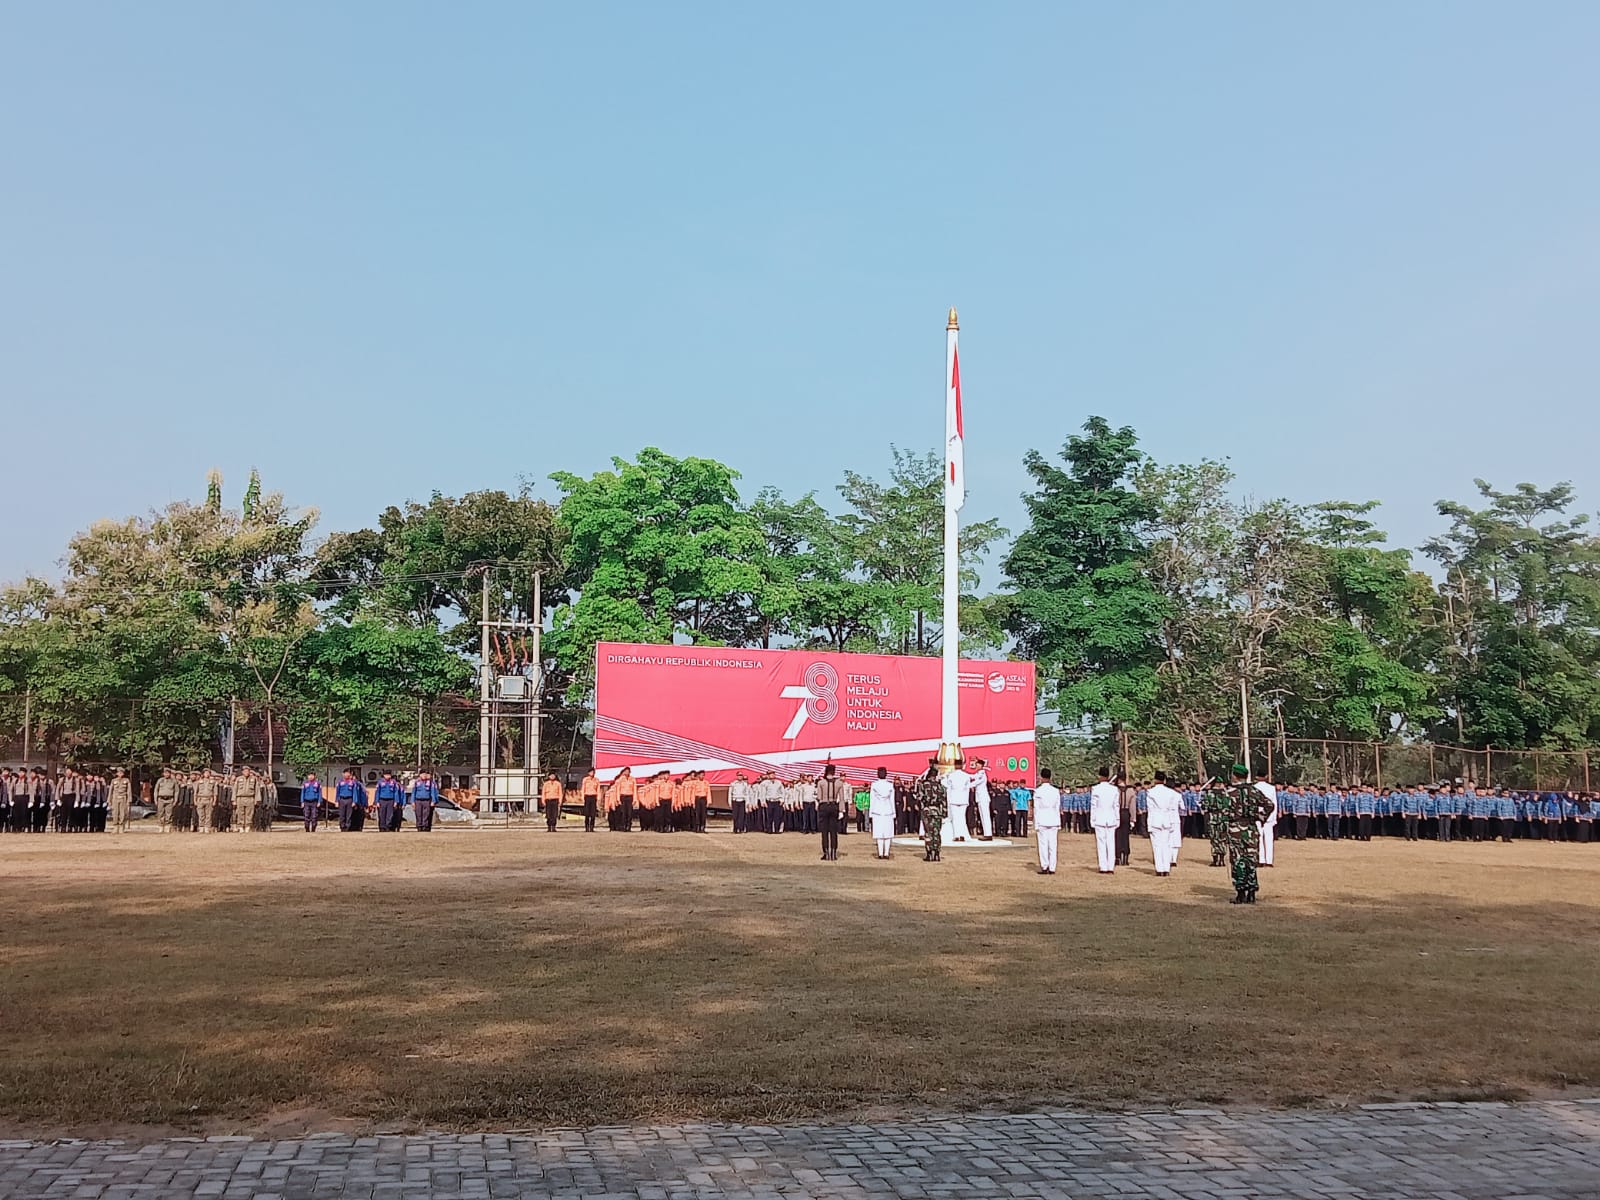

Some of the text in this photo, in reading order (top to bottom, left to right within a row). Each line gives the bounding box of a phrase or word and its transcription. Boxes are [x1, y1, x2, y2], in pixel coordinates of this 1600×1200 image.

[607, 655, 763, 669] DIRGAHAYU REPUBLIK INDONESIA
[847, 674, 881, 685] TERUS
[846, 686, 889, 697] MELAJU
[779, 662, 839, 740] 78
[847, 698, 882, 708] UNTUK
[846, 709, 903, 721] INDONESIA
[847, 721, 877, 731] MAJU
